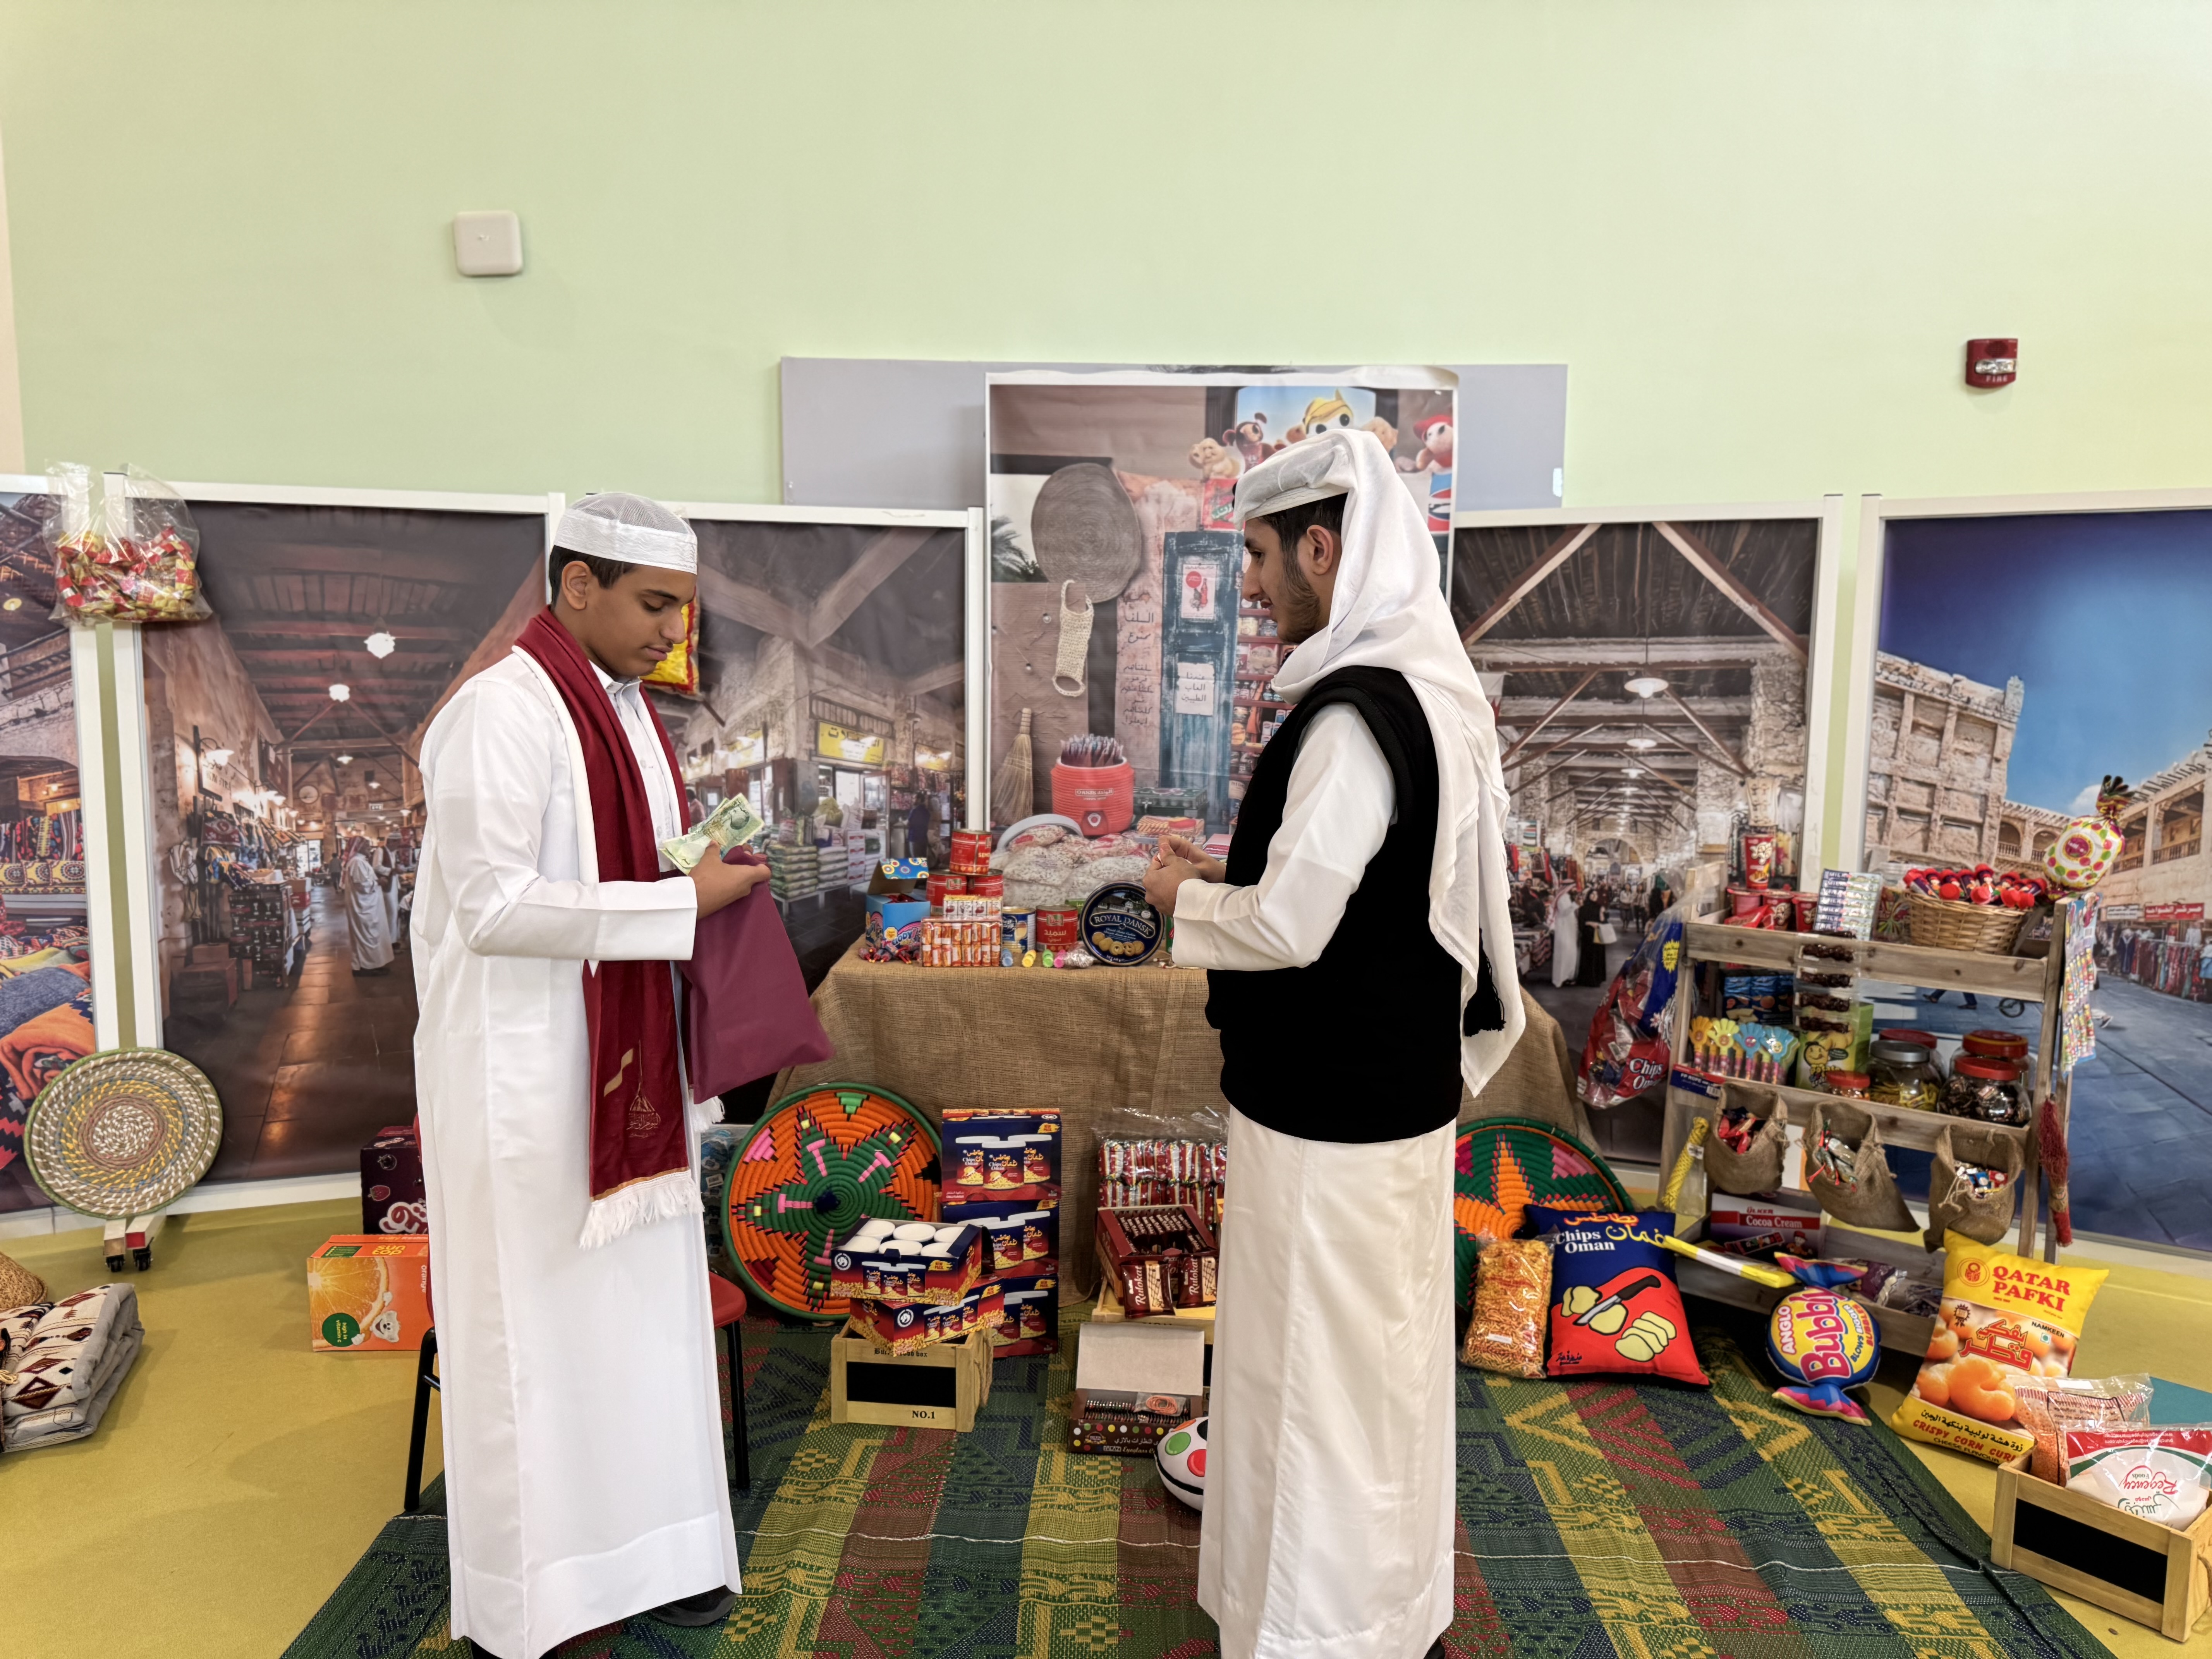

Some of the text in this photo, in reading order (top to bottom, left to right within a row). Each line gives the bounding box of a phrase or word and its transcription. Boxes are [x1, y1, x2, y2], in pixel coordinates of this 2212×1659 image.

[1185, 683, 1205, 692] العاب
[1181, 694, 1206, 703] الطيبين
[1124, 917, 1153, 935] DANSK
[1630, 1058, 1664, 1079] Chips
[1563, 1212, 1640, 1226] بطاطس
[1747, 1206, 1774, 1214] ÜLKER
[1746, 1215, 1803, 1228] Cocoa Cream
[1556, 1229, 1602, 1245] Chips
[1565, 1241, 1616, 1254] Oman
[1135, 1265, 1146, 1305] Rulokat
[1189, 1258, 1200, 1295] Rulokat
[1993, 1266, 2071, 1296] QATAR
[1993, 1280, 2066, 1312] PAFKI
[1778, 1305, 1797, 1355] ANGLO
[1788, 1285, 1851, 1383] Bubbly
[1843, 1304, 1864, 1362] BLOWS BIGGER
[2031, 1321, 2065, 1338] NAMKEEN
[1958, 1335, 2033, 1371] قطر
[912, 1410, 936, 1419] NO.1
[1921, 1409, 1941, 1422] الجبن
[1941, 1417, 1963, 1432] بنكهة
[1913, 1419, 1949, 1438] CRISPY
[1954, 1435, 1984, 1451] CORN
[1990, 1434, 2010, 1446] هشة
[1934, 1437, 2000, 1463] CHEESE FLAVOUR
[2118, 1465, 2178, 1495] Regency
